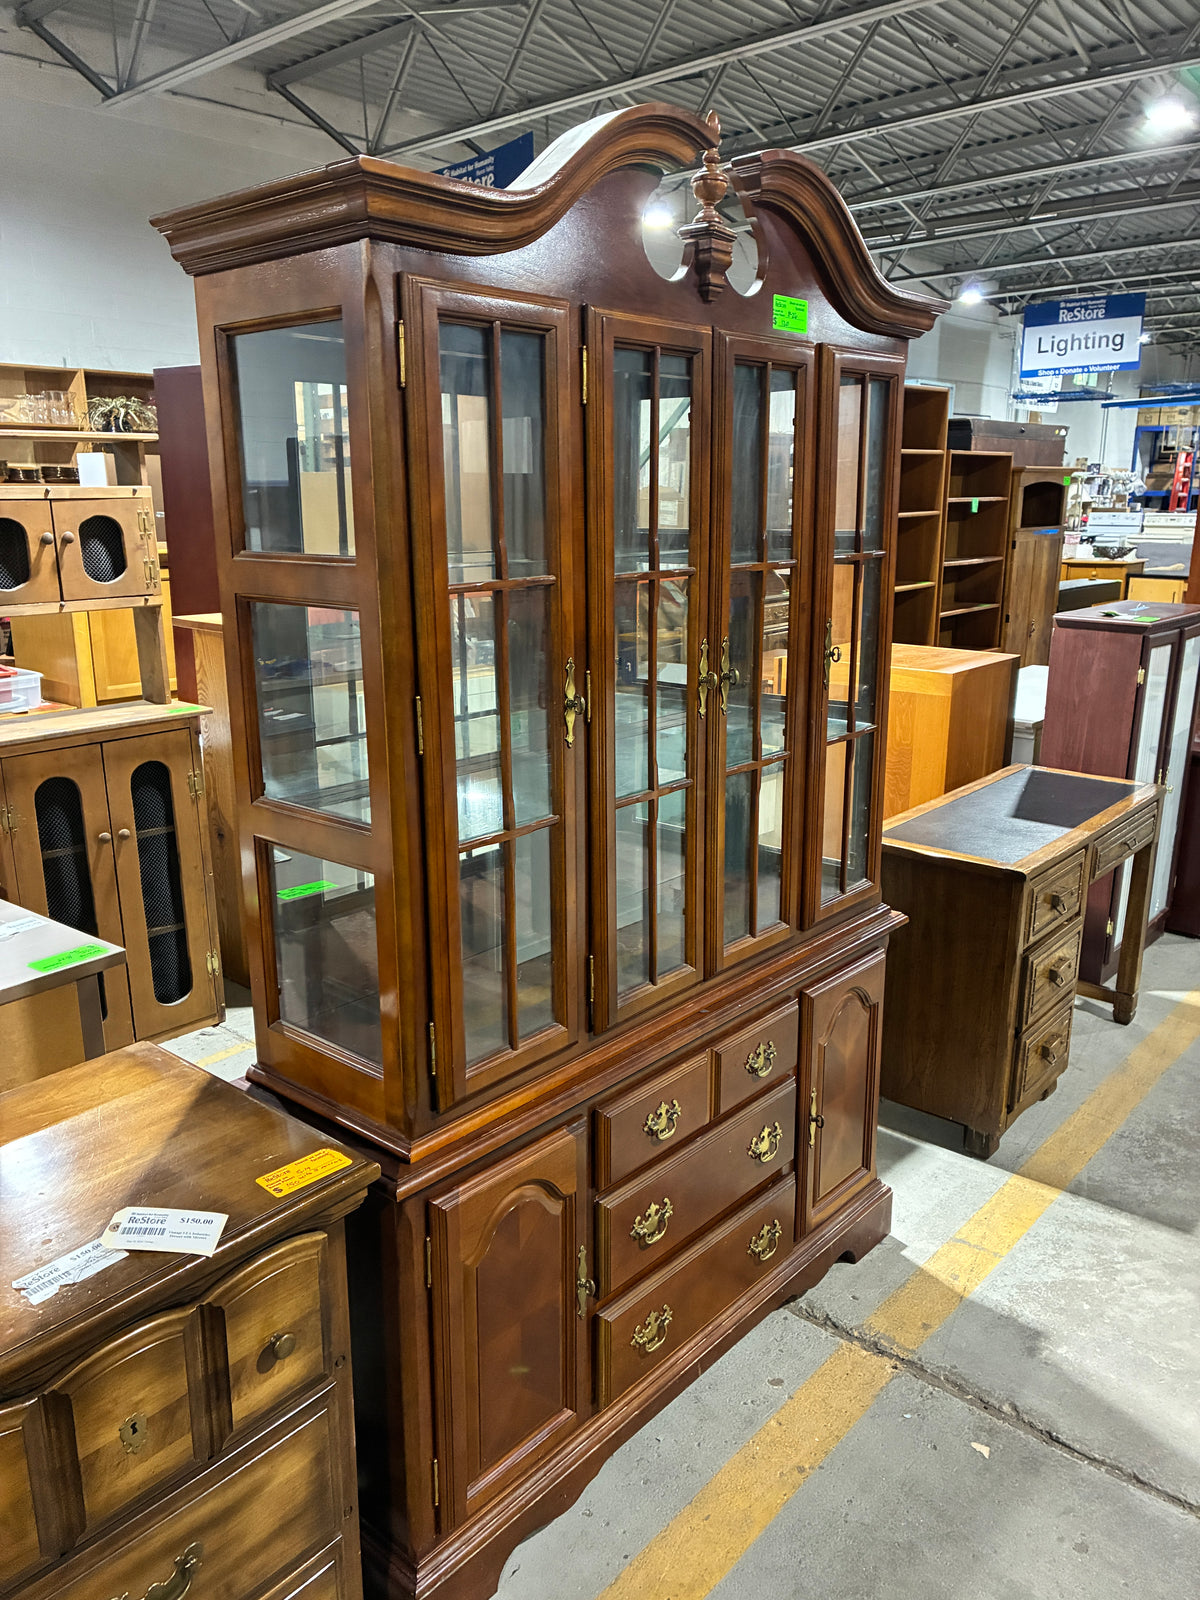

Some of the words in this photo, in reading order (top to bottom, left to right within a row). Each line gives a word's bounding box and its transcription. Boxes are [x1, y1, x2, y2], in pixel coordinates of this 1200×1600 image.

[1059, 307, 1106, 322] ReStore
[1037, 331, 1125, 357] Lighting
[1038, 368, 1055, 377] Shop
[1060, 366, 1083, 375] Donate
[1088, 364, 1121, 372] Volunteer
[127, 1216, 167, 1225] ReStore
[179, 1217, 214, 1225] $150.00
[69, 1242, 103, 1261] $150.00
